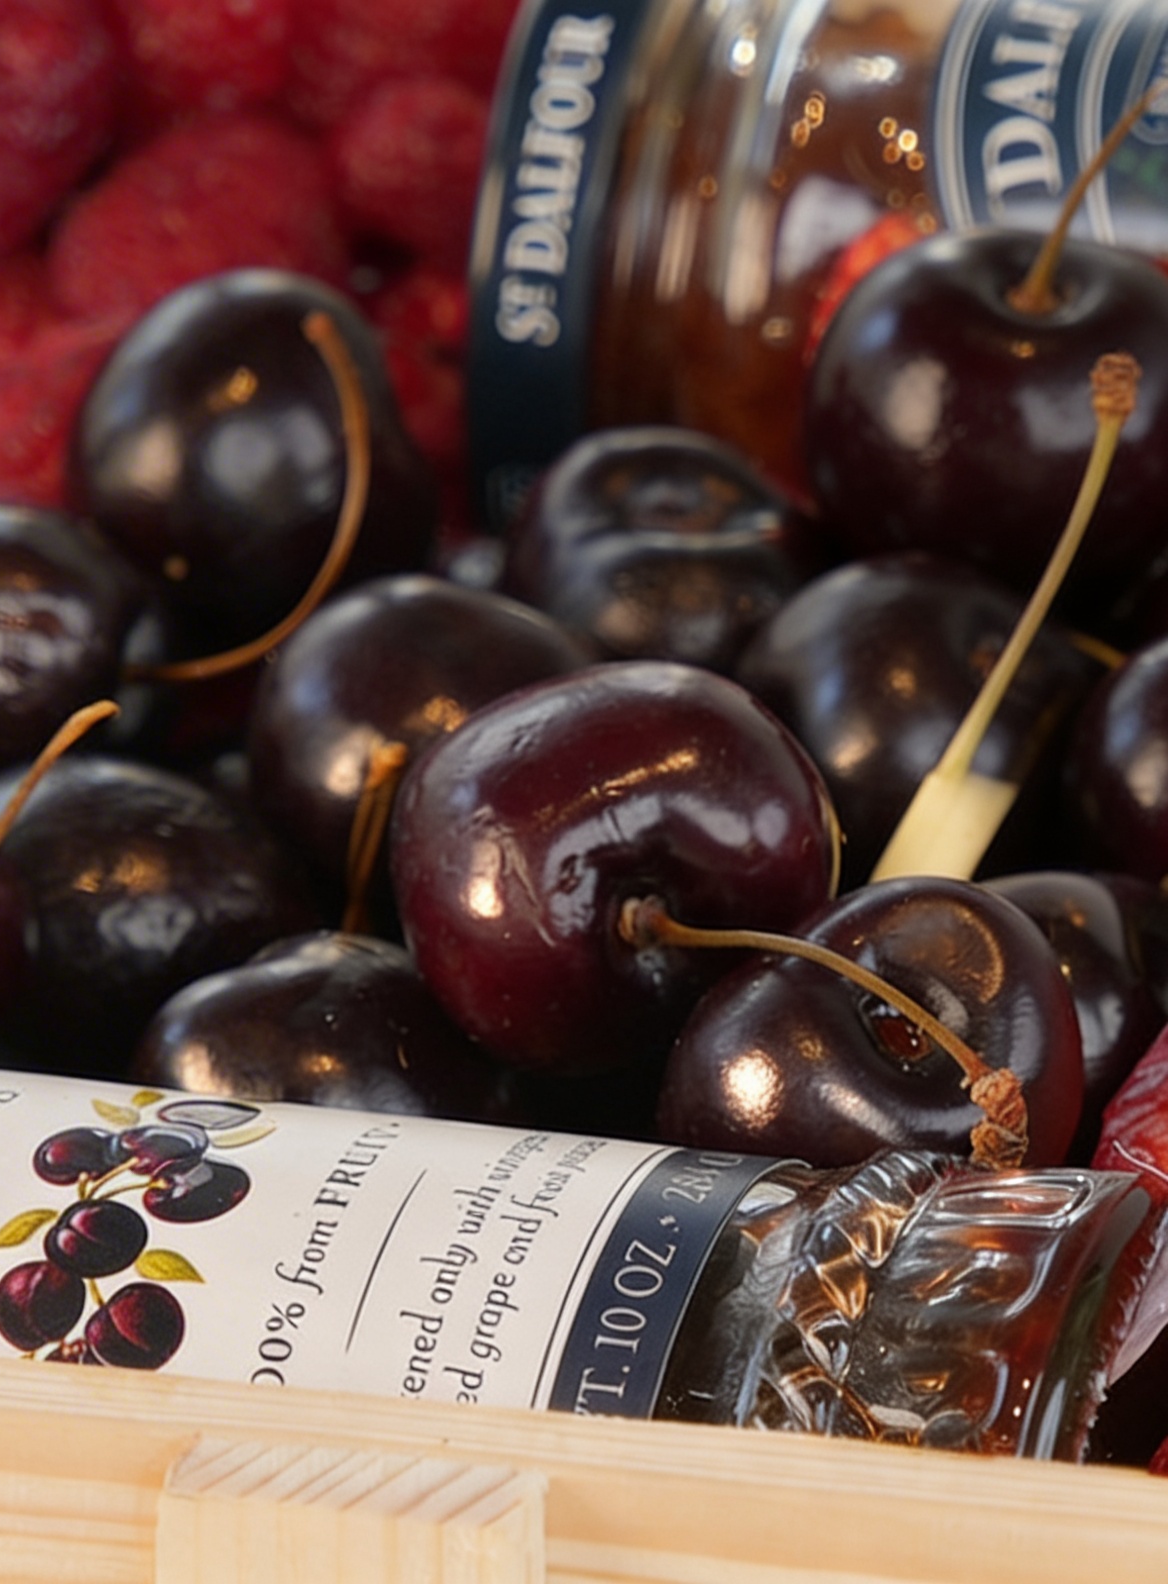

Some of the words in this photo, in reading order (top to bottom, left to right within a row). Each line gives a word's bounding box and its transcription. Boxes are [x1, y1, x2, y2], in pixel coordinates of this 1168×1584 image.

[504, 14, 615, 275] DALFOUR
[274, 1218, 339, 1296] from
[420, 1243, 479, 1305] only
[399, 1310, 444, 1399] ened
[470, 1272, 520, 1362] grape
[594, 1307, 648, 1355] 10
[574, 1364, 631, 1414] T.
